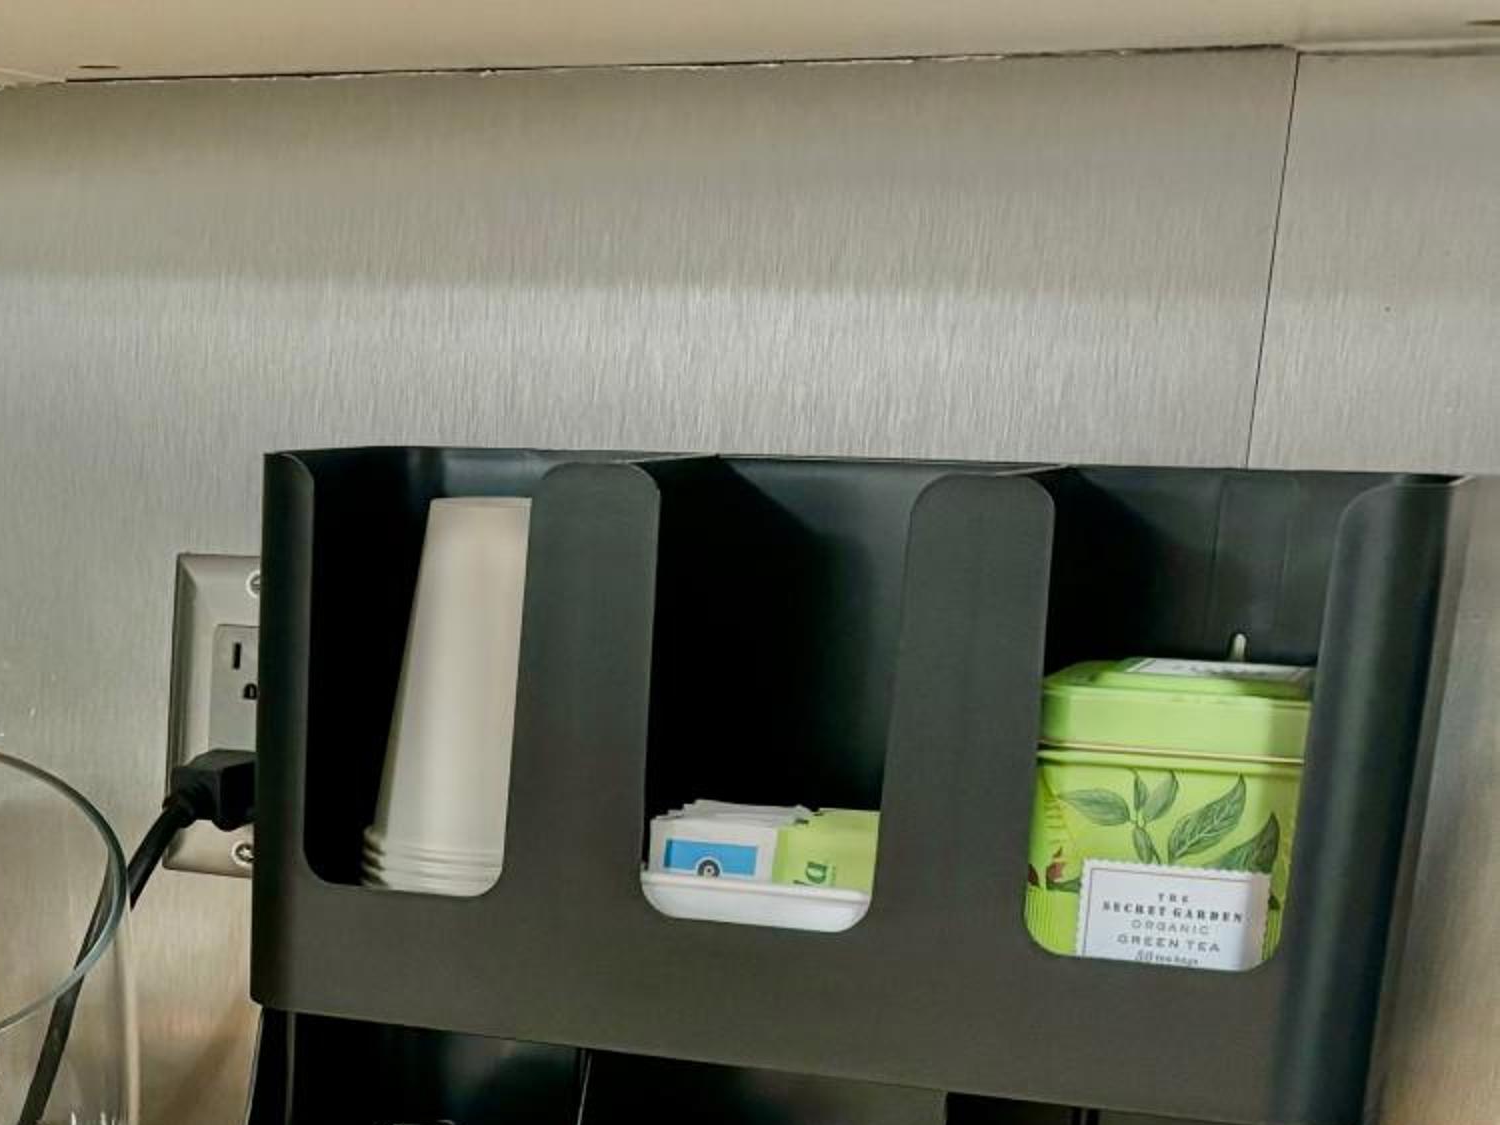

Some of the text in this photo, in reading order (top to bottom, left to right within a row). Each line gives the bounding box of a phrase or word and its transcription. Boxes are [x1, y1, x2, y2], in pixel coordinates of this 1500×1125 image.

[1101, 900, 1244, 924] SECRET GARDEN
[1130, 918, 1211, 936] ORGANIC
[1116, 933, 1221, 953] GREEN TEA
